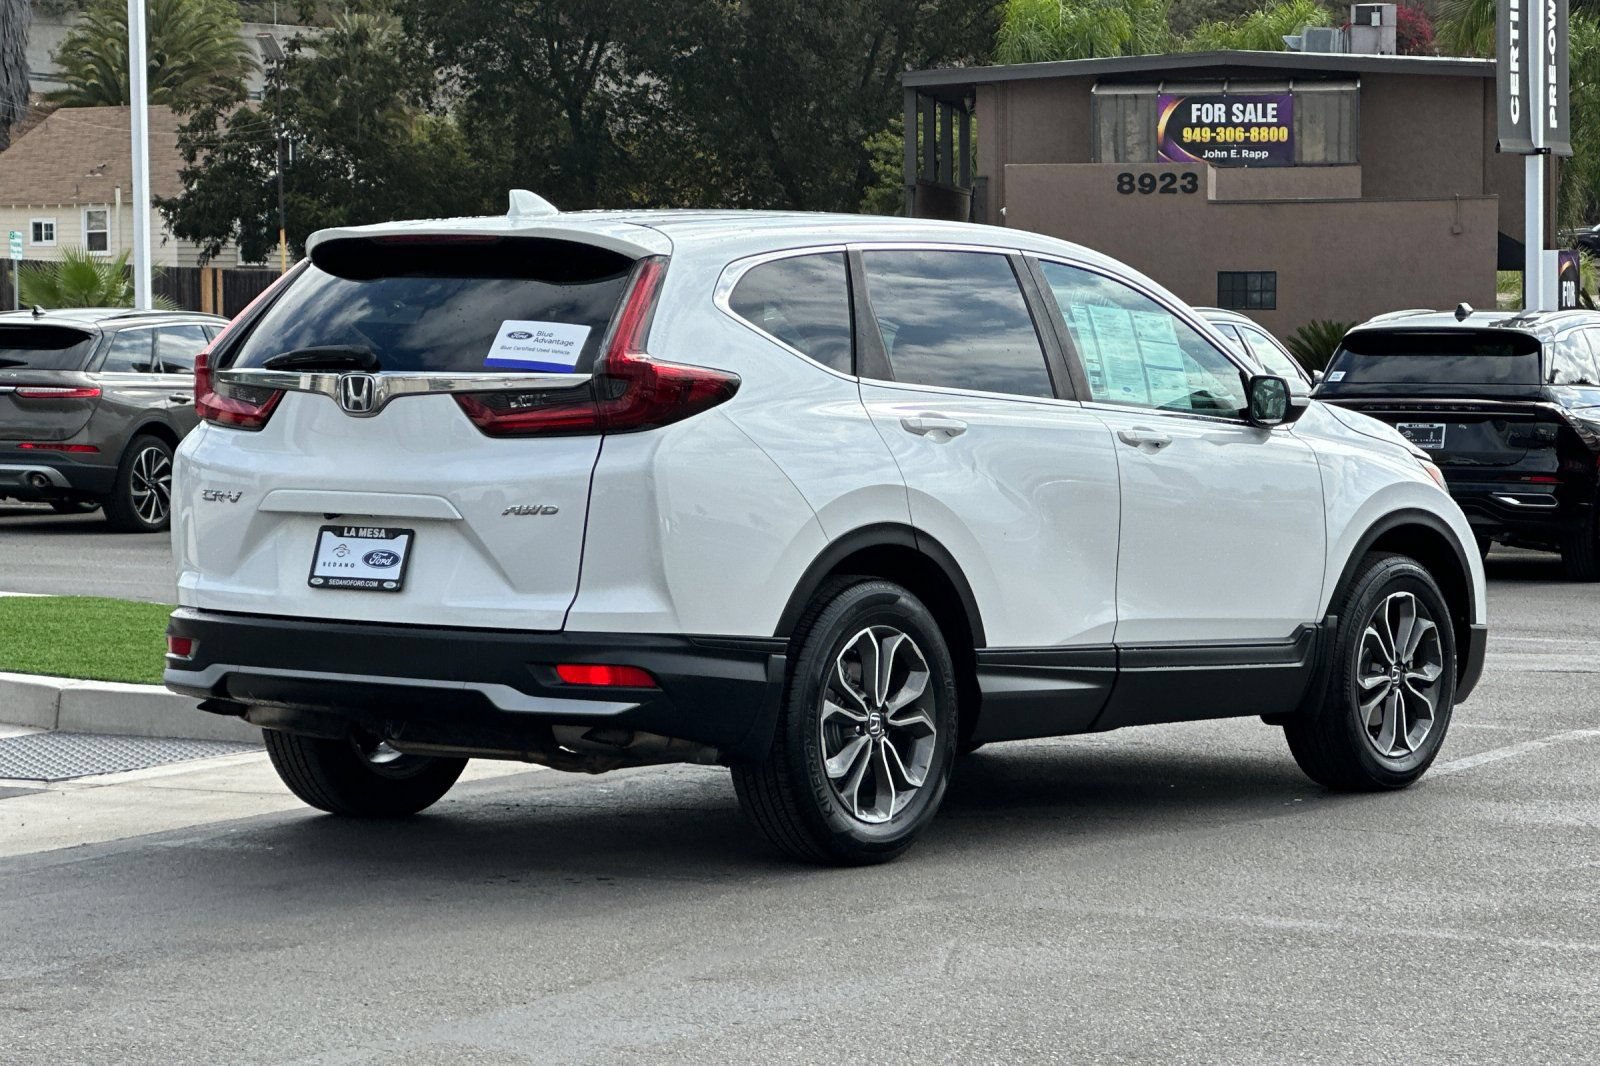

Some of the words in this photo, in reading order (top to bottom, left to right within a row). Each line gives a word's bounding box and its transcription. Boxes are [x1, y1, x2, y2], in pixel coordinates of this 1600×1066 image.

[1191, 103, 1226, 123] FOR
[1231, 103, 1278, 123] SALE
[1182, 126, 1289, 143] 949-306-8800
[1203, 149, 1228, 159] John
[1230, 149, 1240, 158] E.
[1242, 149, 1269, 160] Rapp
[1116, 172, 1199, 195] 8923
[1562, 281, 1576, 307] FOR
[536, 330, 554, 338] Blue
[533, 337, 574, 347] Advantage
[202, 490, 243, 503] CR-V
[501, 504, 559, 516] AWD
[343, 527, 355, 537] LA
[358, 528, 386, 538] MESA
[368, 552, 394, 566] Ford
[328, 578, 378, 587] SEDANOFORD.COM
